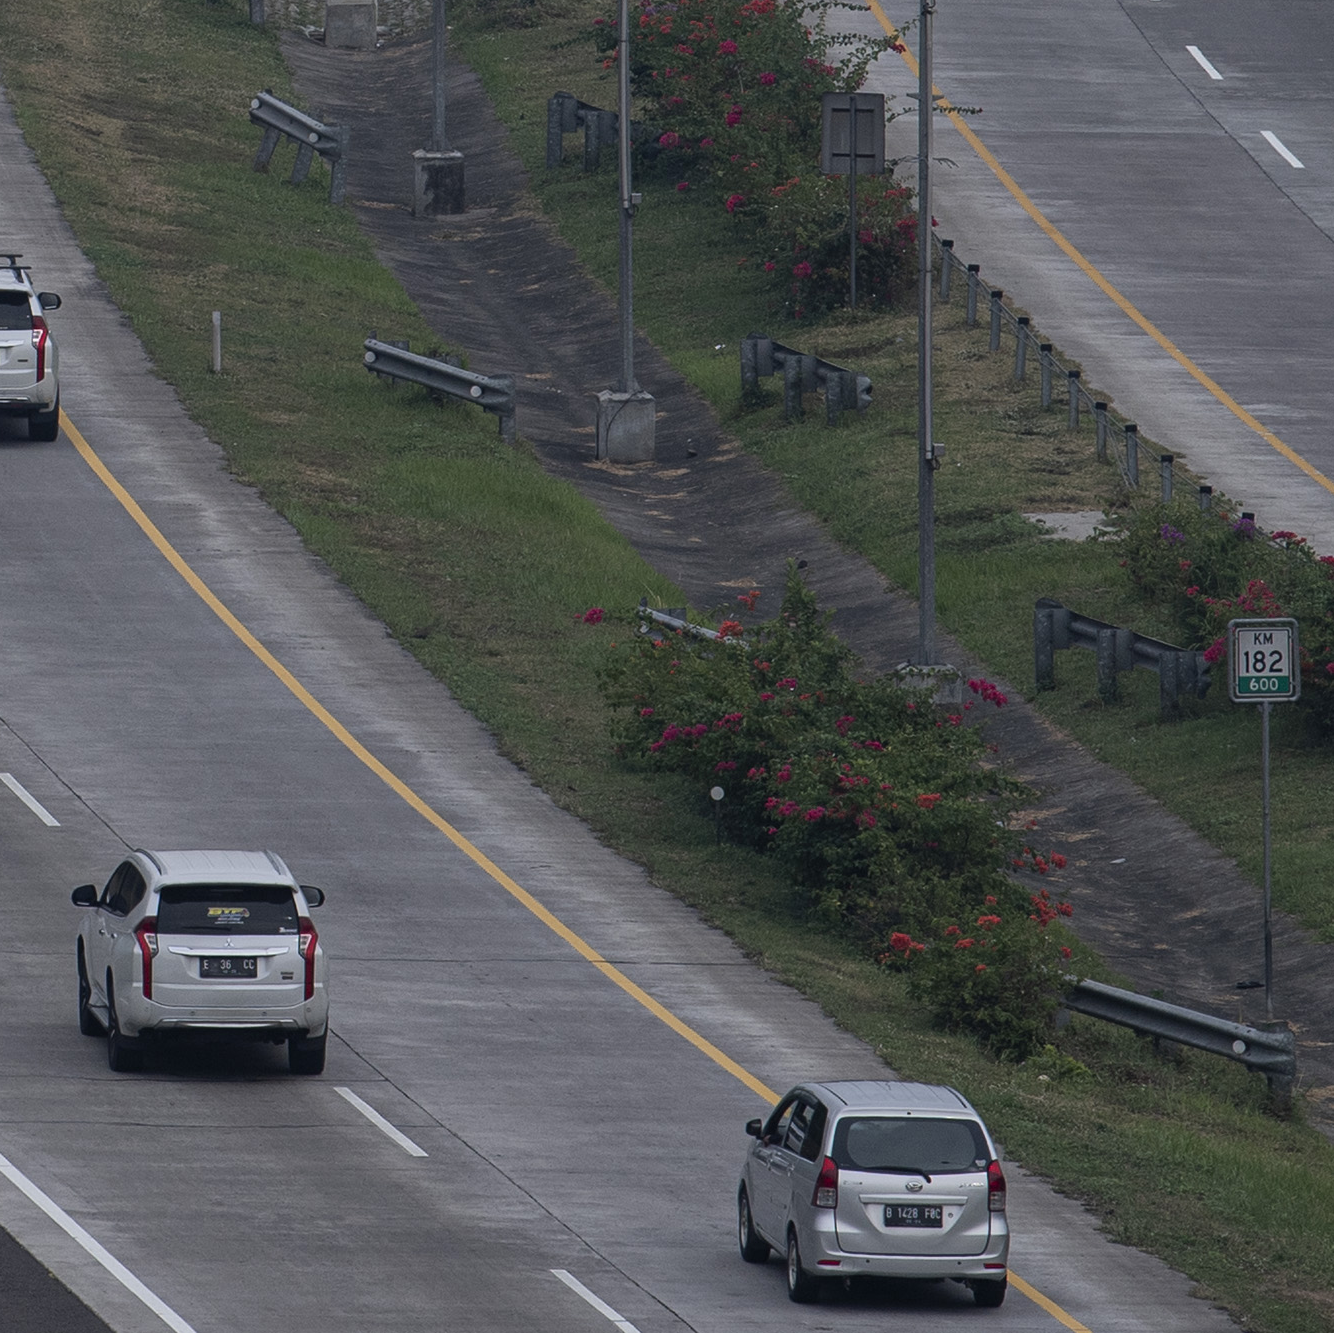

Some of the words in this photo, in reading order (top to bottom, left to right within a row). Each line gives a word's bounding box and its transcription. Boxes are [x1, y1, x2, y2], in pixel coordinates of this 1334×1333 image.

[1254, 632, 1273, 645] KM
[1243, 650, 1283, 673] 182
[1250, 678, 1279, 691] 600
[203, 959, 209, 970] E
[220, 959, 232, 970] 36
[243, 959, 255, 970] CC
[886, 1207, 892, 1218] B
[898, 1207, 919, 1219] 1428
